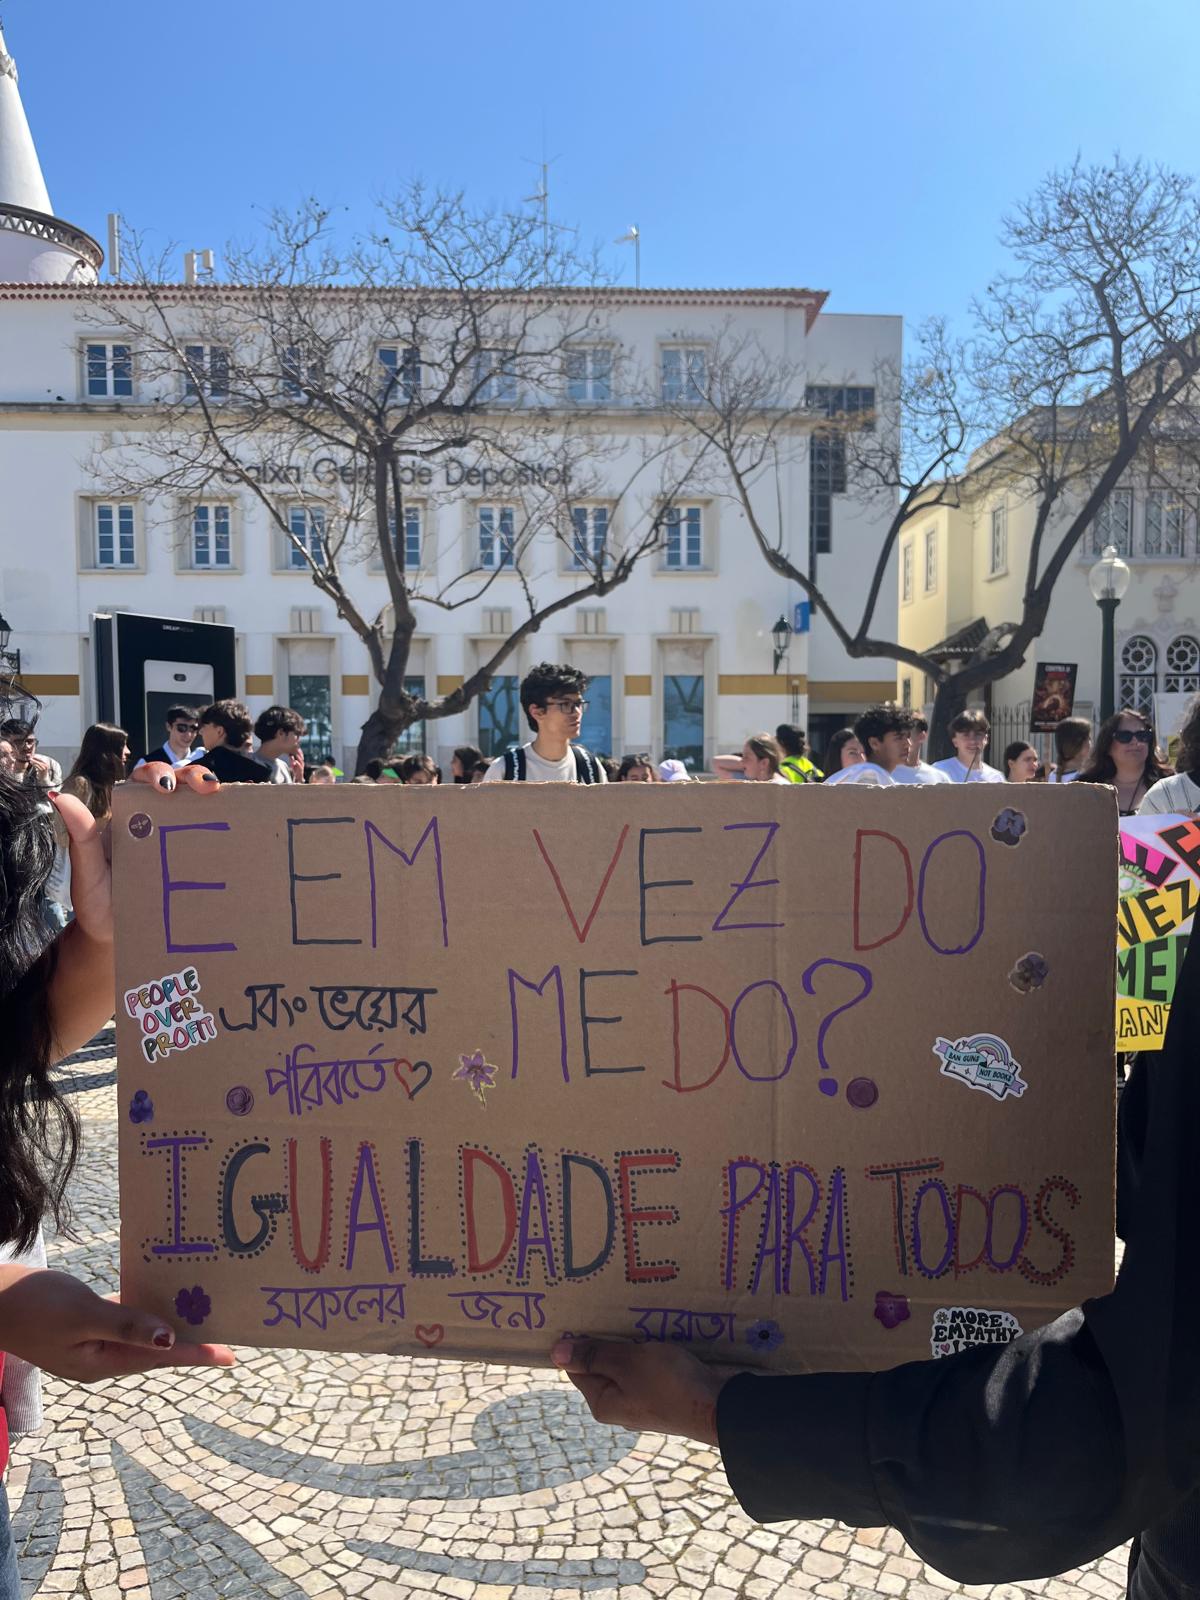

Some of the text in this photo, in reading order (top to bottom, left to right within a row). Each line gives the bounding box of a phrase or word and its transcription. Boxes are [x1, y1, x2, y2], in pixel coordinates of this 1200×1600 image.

[222, 457, 301, 485] Caixa
[399, 460, 433, 485] de
[159, 815, 986, 955] E EM VEZ DO
[1118, 878, 1192, 947] VEZ
[127, 969, 198, 1016] PEOPLE
[219, 983, 308, 1032] এবং
[143, 997, 201, 1034] OVER
[507, 957, 873, 1098] MEDO?
[144, 1016, 215, 1061] PROFIT
[949, 1052, 961, 1061] BAN
[980, 1068, 1012, 1082] NOT BOOKS
[141, 1130, 1082, 1301] IGUALDADE PARA TODOS
[933, 1322, 1019, 1343] EMPATHY
[950, 1310, 1003, 1328] MORE
